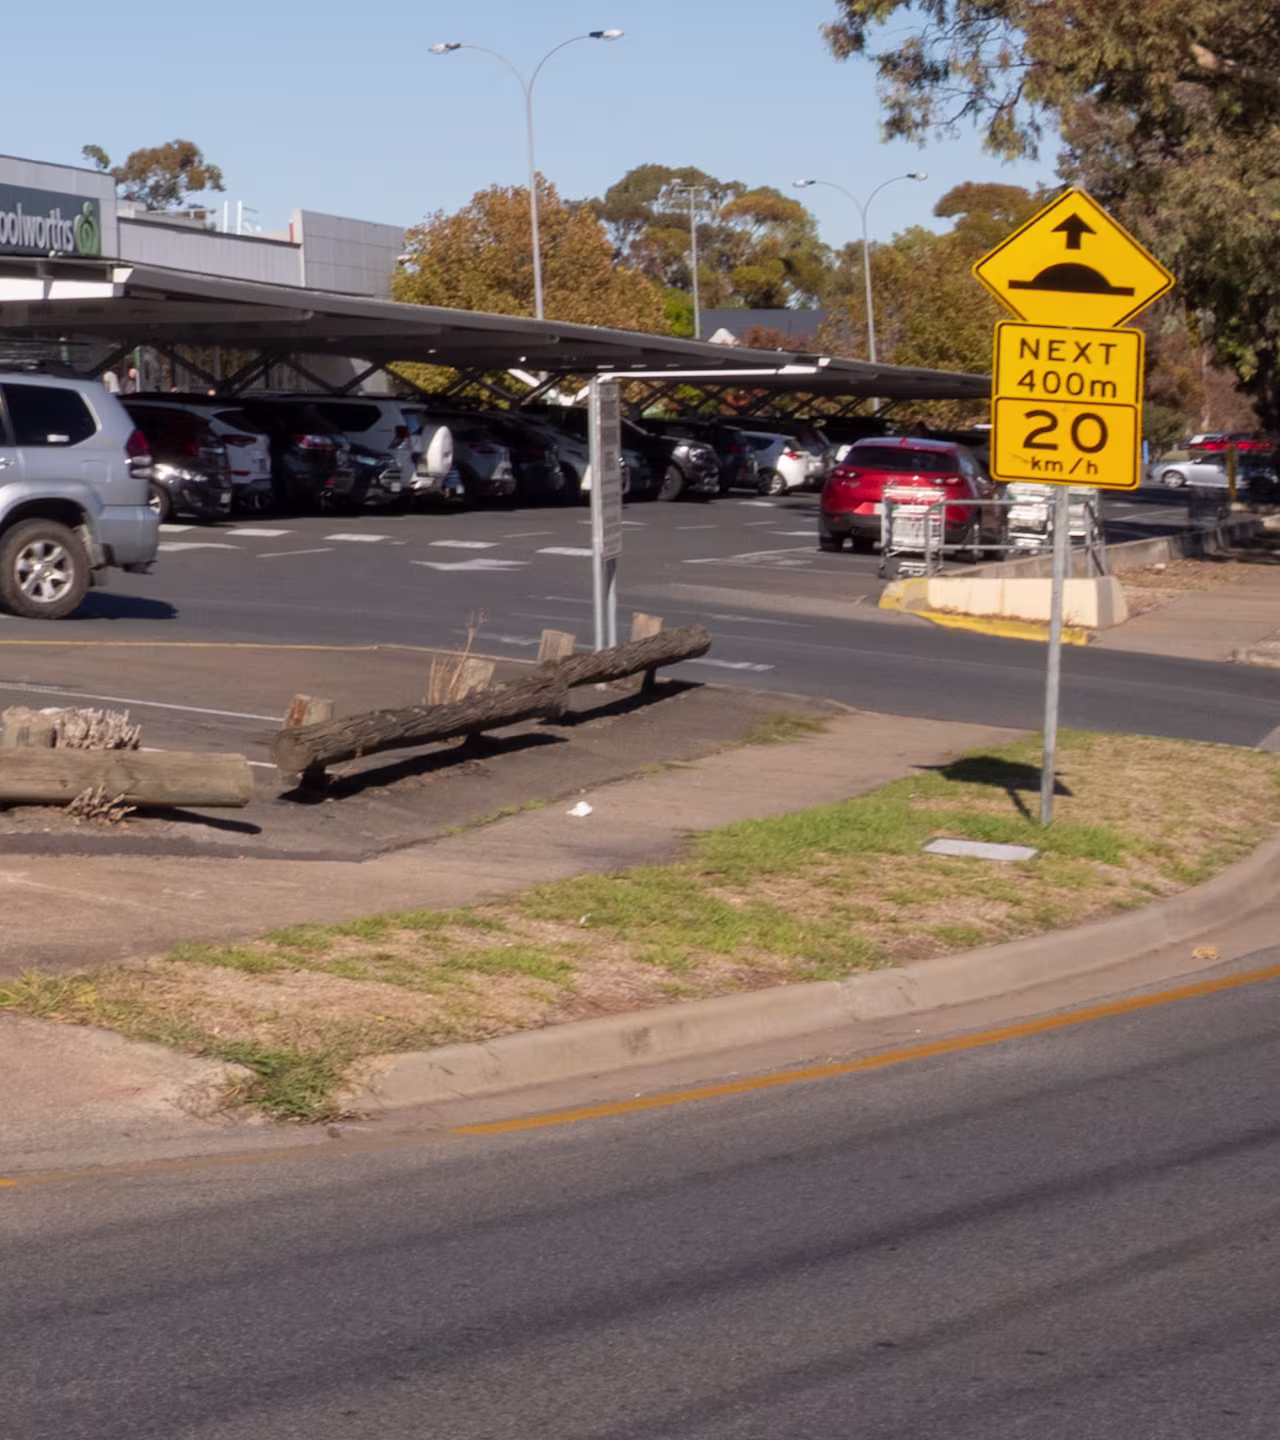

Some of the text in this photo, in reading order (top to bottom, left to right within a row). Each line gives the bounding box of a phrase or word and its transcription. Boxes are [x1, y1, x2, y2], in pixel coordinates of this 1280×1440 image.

[1019, 338, 1118, 365] NEXT
[1017, 370, 1117, 398] 400m
[1023, 410, 1108, 453] 20
[1031, 456, 1099, 475] km/h
